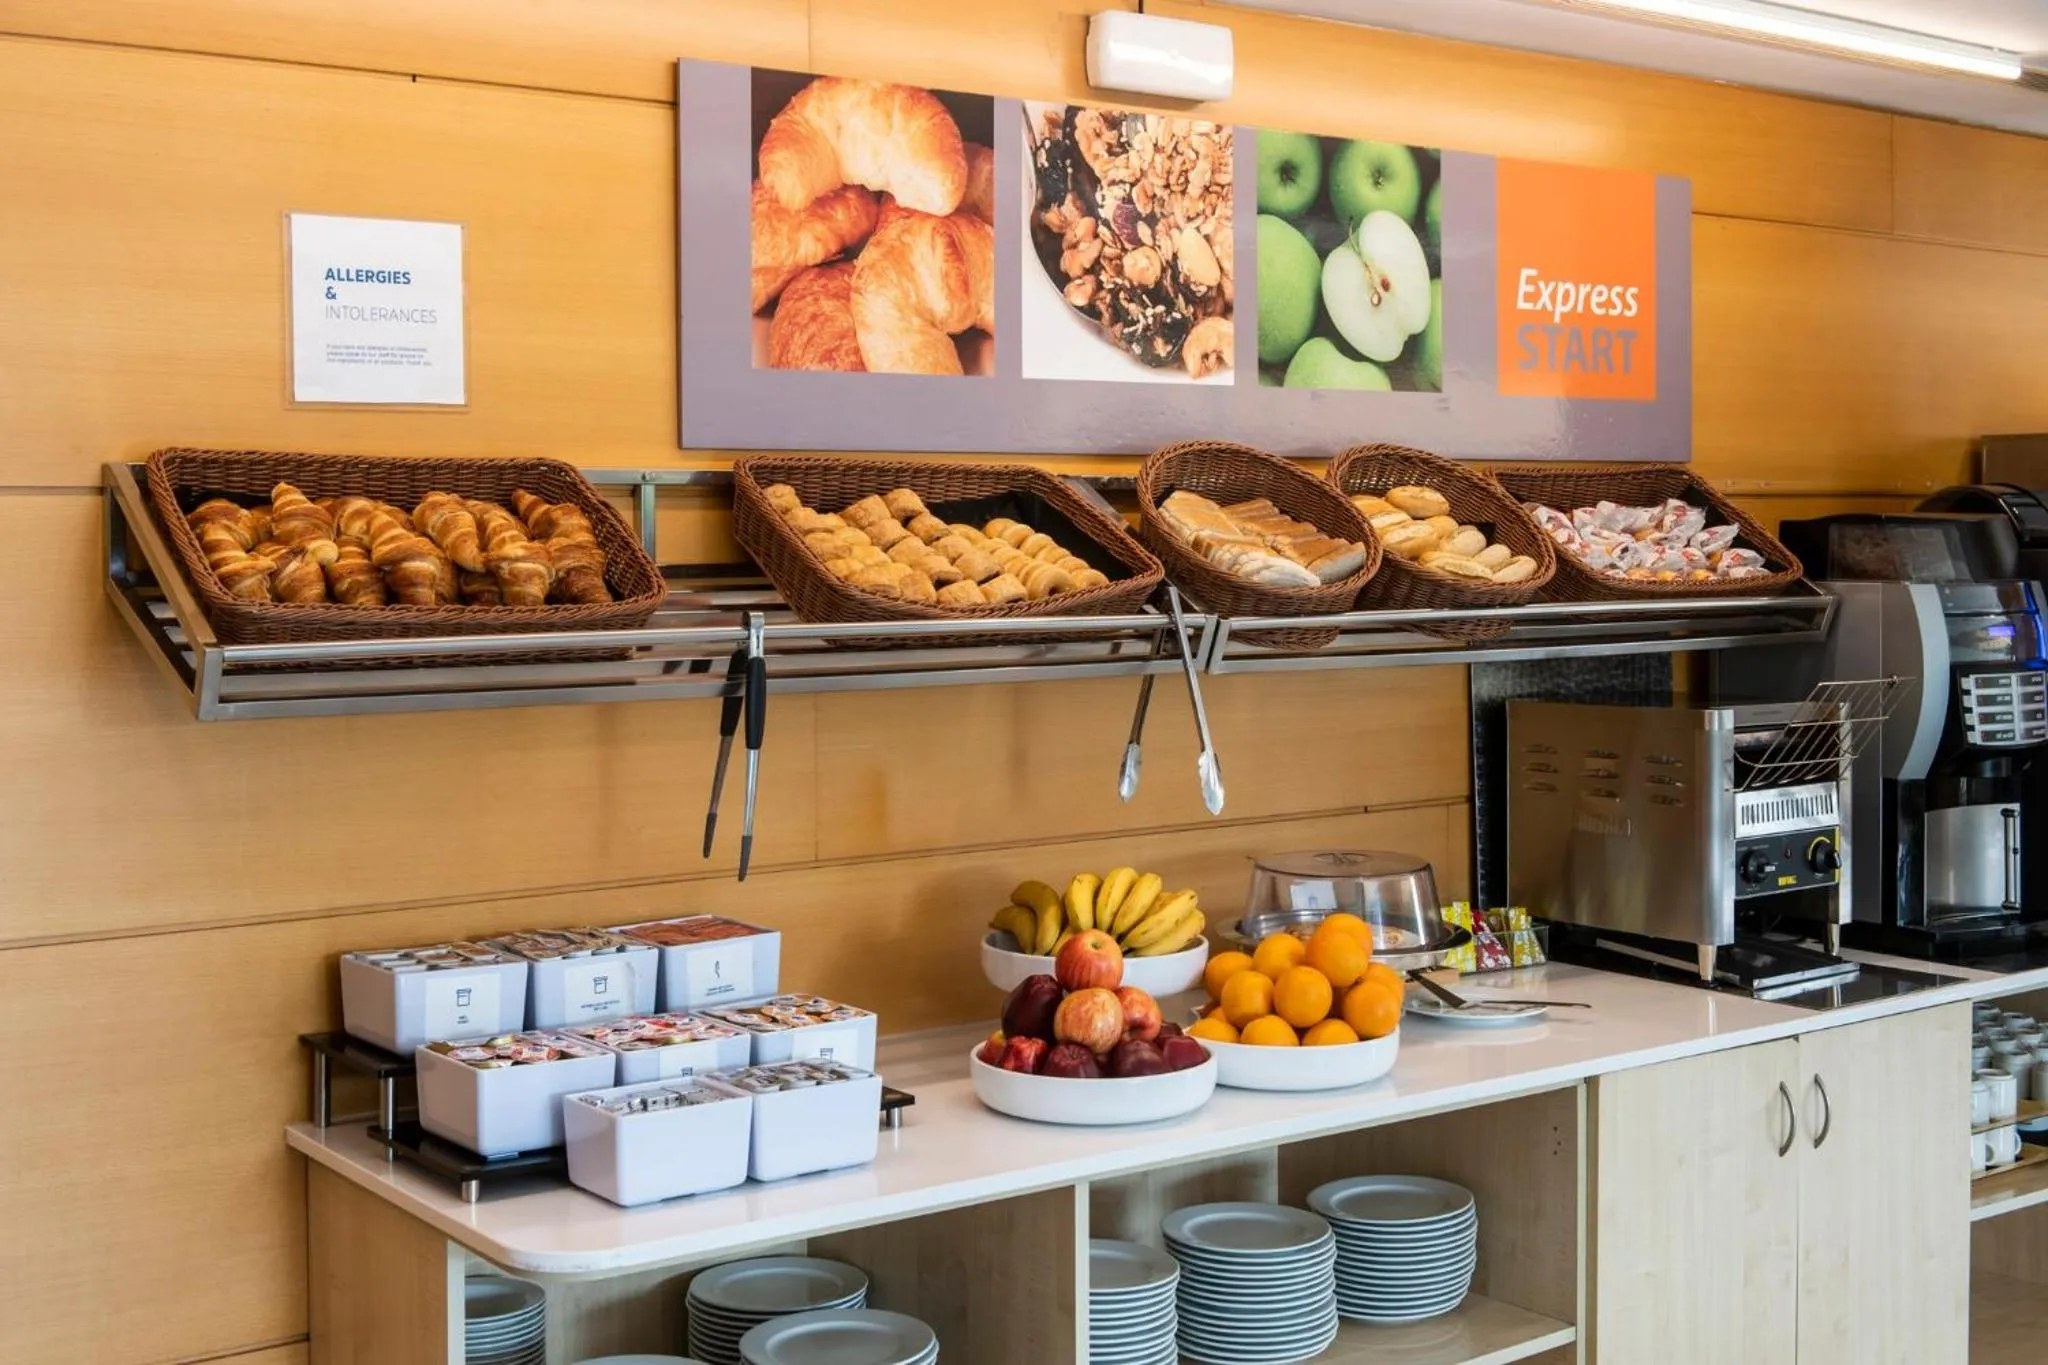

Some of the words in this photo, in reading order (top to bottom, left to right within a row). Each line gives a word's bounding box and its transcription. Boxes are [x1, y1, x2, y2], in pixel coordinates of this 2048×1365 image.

[324, 267, 412, 286] ALLERGIES
[325, 286, 337, 300] &
[1516, 267, 1640, 324] Express
[325, 304, 438, 325] INTOLERANCES
[1517, 323, 1638, 375] START
